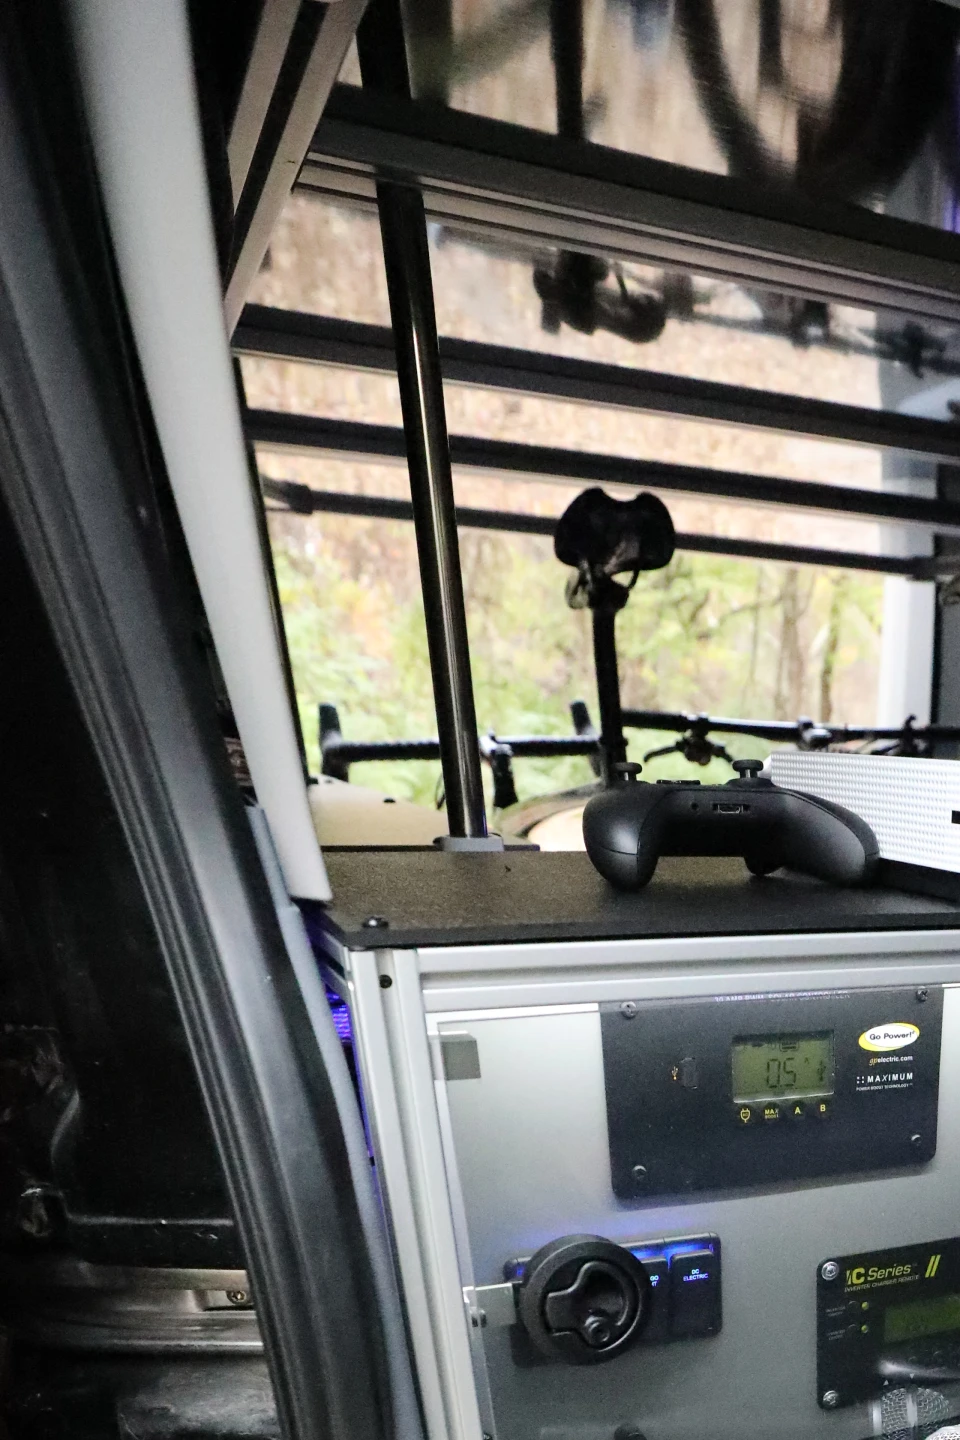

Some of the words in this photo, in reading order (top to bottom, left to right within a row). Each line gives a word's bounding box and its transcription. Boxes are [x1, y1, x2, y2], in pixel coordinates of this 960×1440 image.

[869, 1033, 881, 1041] Go
[869, 1055, 913, 1067] gpelectric.com
[867, 1072, 913, 1083] MAXIMUM
[794, 1106, 802, 1115] A
[819, 1104, 826, 1112] B
[867, 1263, 912, 1281] Series
[683, 1273, 709, 1281] ELECTRIC
